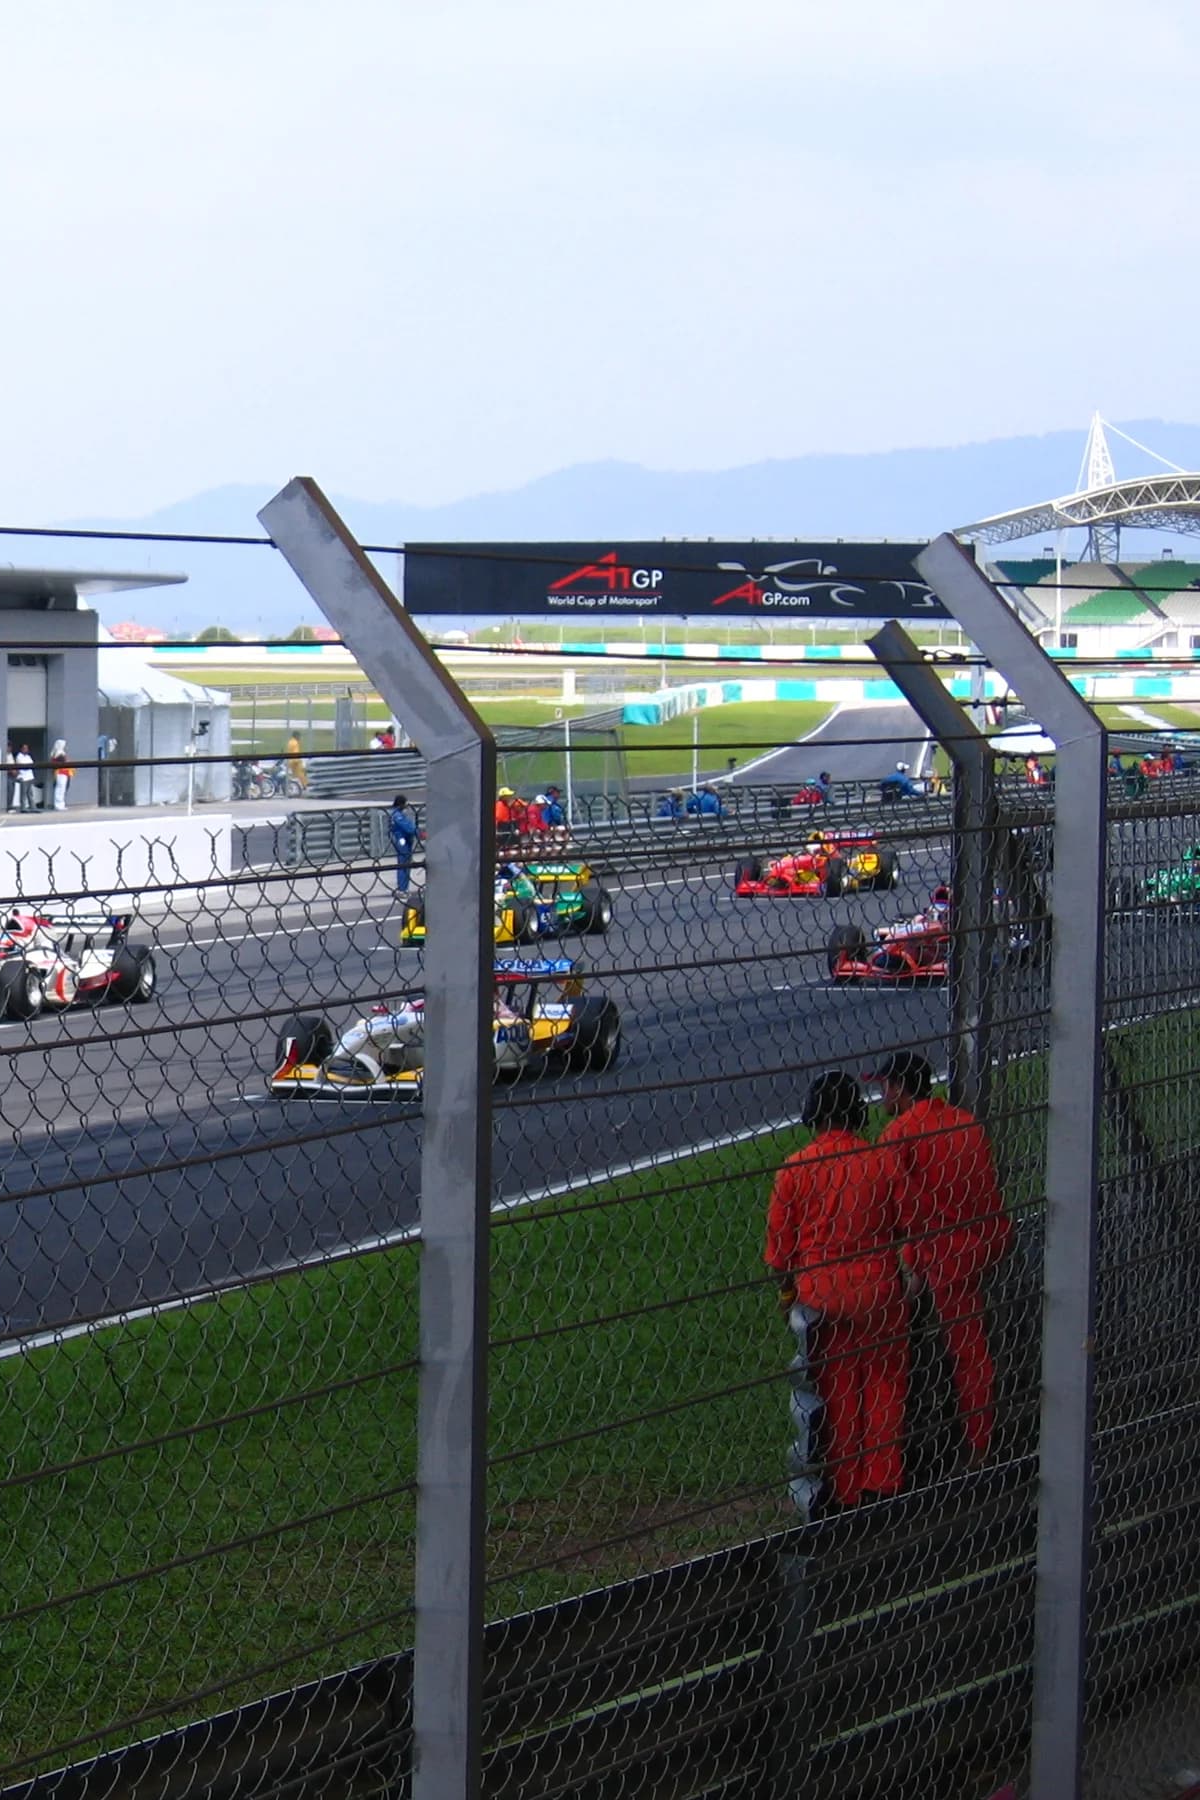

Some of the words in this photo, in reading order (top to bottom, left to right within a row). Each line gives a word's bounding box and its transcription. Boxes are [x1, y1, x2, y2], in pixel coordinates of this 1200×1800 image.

[548, 595, 575, 605] World
[577, 595, 596, 607] Cup
[598, 595, 608, 605] of
[609, 596, 658, 607] Motorsport
